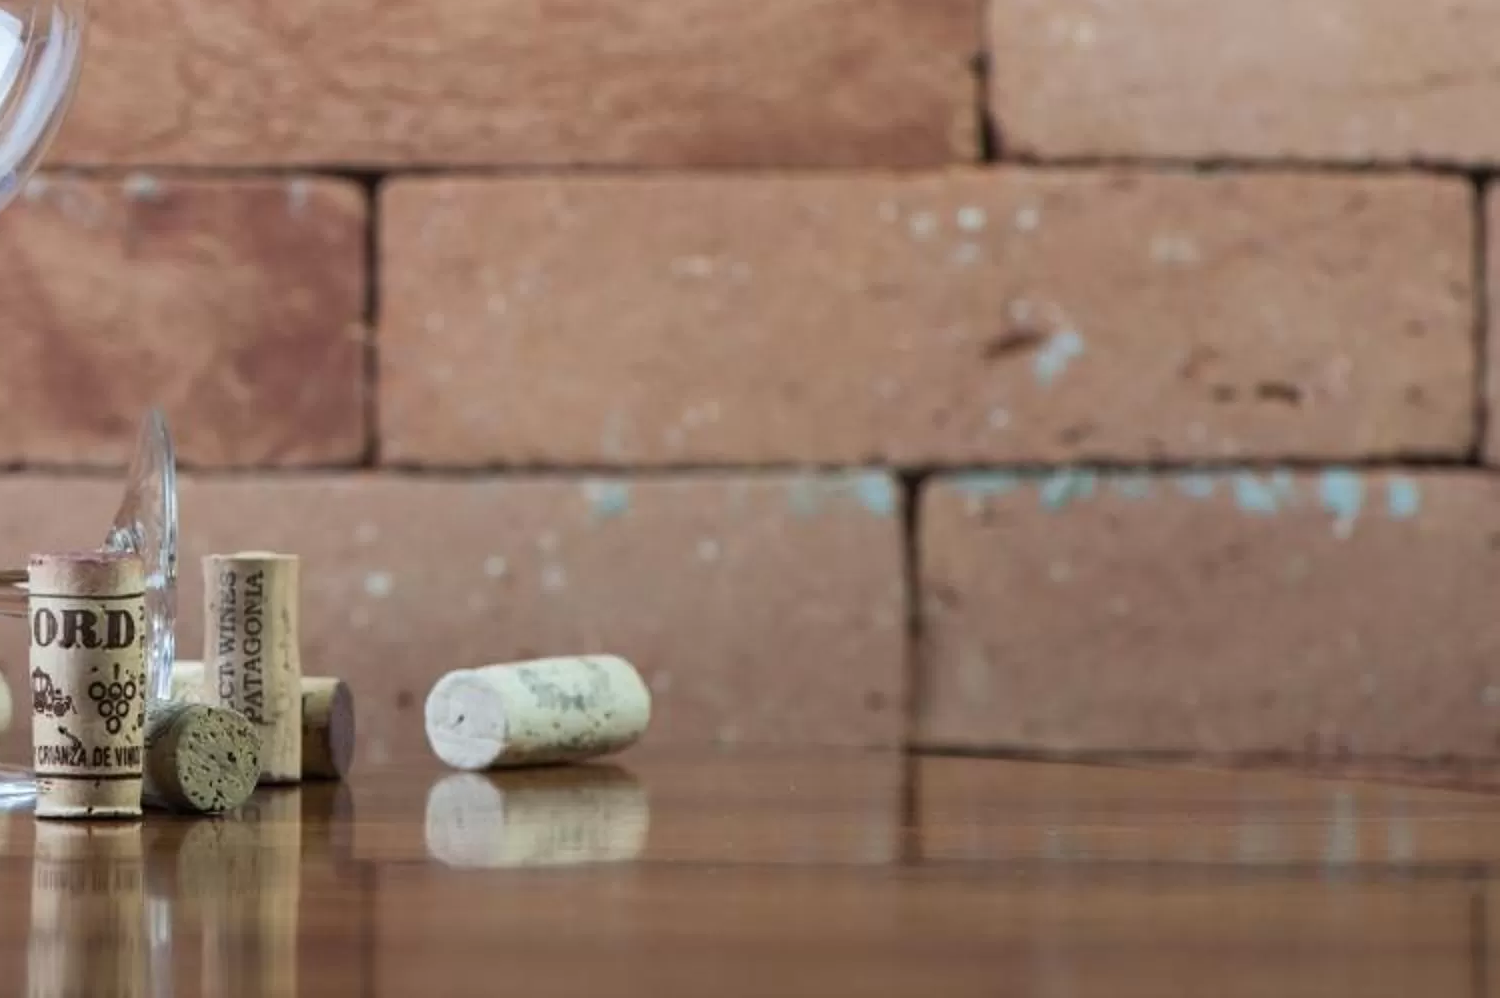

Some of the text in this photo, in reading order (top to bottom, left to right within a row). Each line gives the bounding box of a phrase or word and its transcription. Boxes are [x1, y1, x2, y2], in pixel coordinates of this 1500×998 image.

[33, 607, 137, 650] ORD
[243, 569, 265, 725] PATAGONIA
[92, 745, 113, 767] DE
